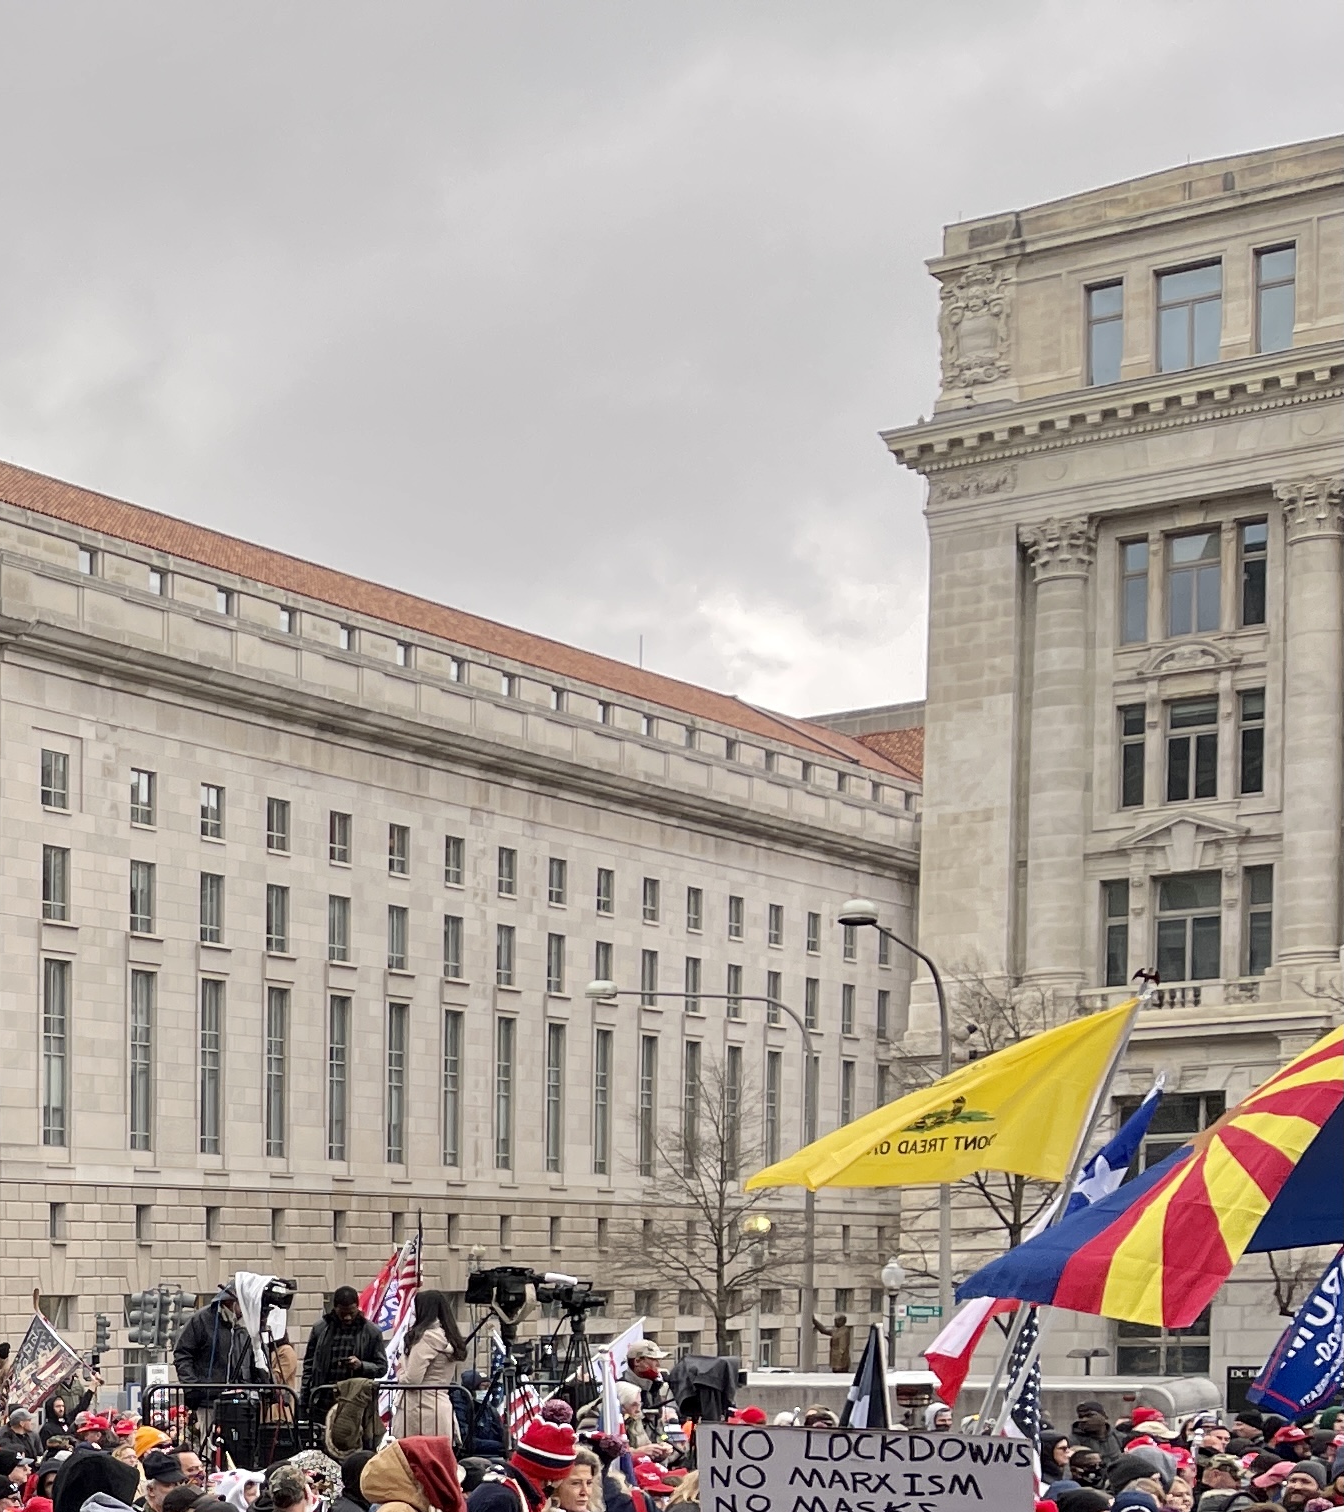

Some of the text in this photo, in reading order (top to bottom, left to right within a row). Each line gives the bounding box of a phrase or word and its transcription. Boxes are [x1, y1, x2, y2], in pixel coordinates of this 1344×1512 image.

[711, 1430, 1032, 1467] NO LOCKDOWNS
[710, 1465, 983, 1500] NO MARXISM
